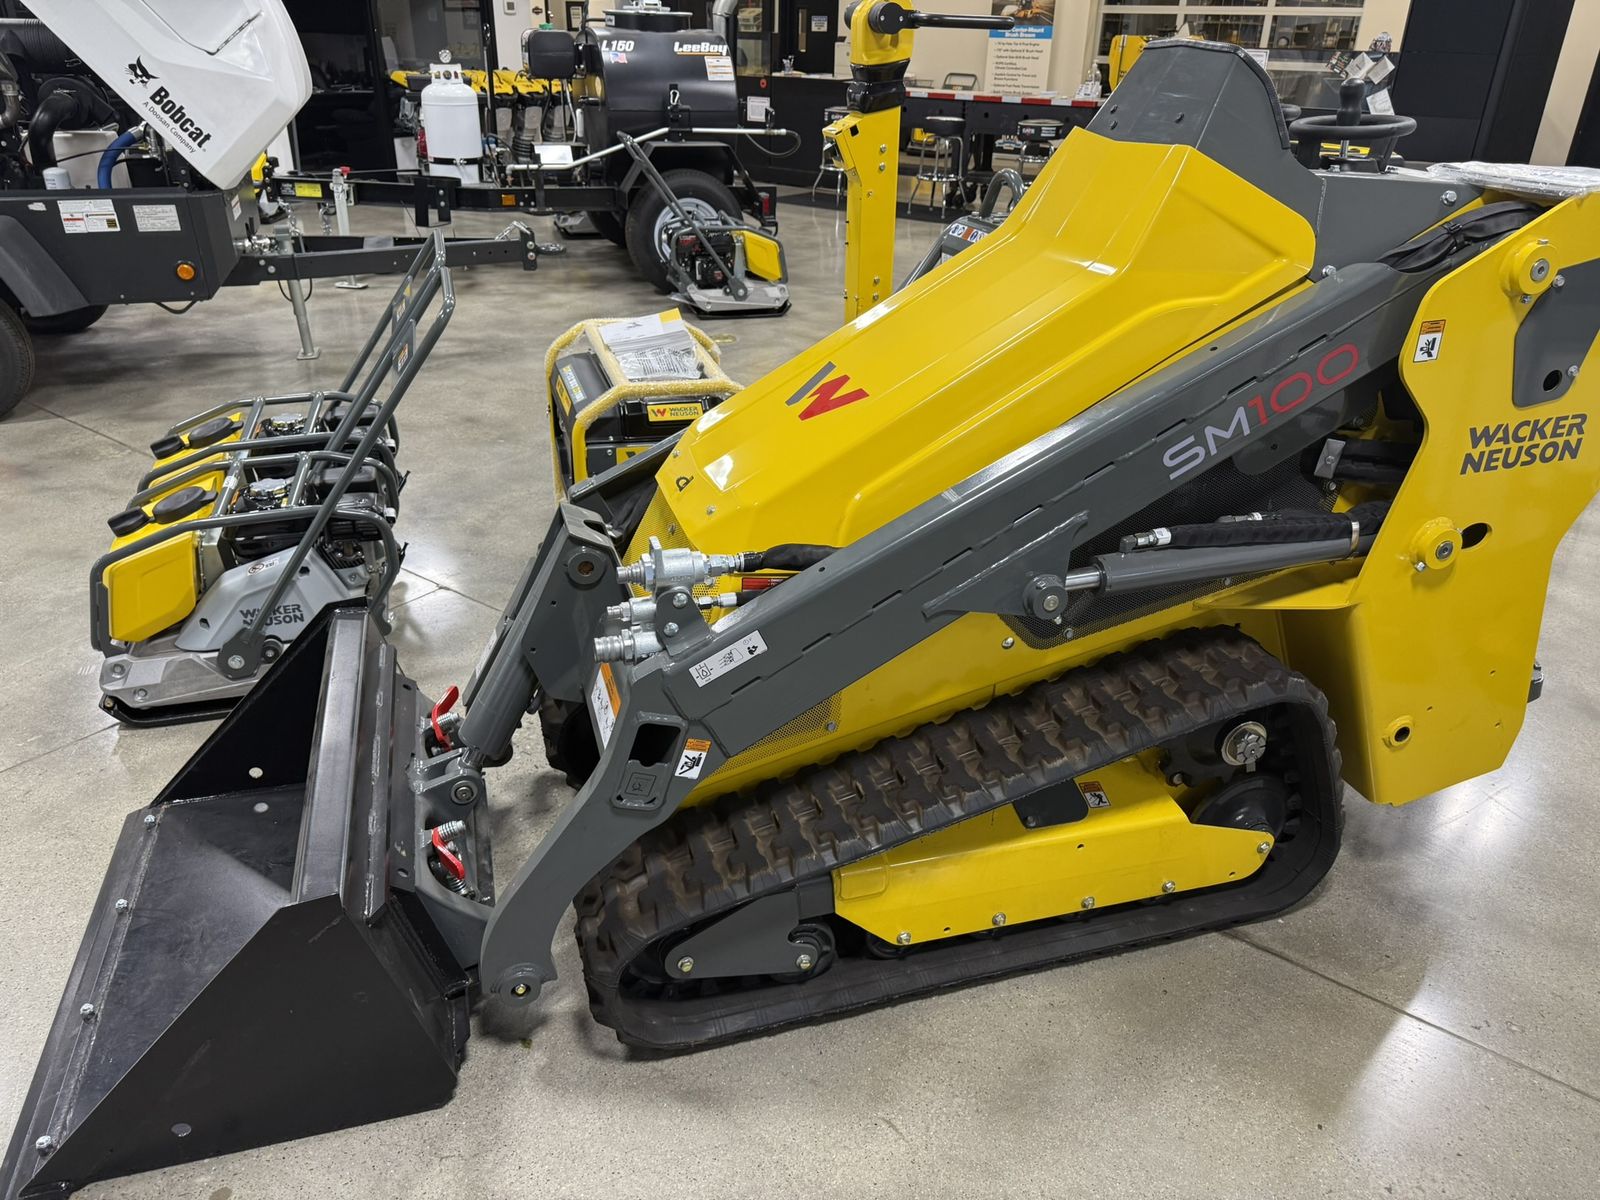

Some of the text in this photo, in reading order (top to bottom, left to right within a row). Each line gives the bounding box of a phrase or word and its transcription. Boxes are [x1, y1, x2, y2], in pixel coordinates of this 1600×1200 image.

[674, 41, 729, 56] LeeBoy
[148, 105, 170, 129] Doosan
[169, 126, 197, 154] Company
[149, 86, 212, 149] Bobcat
[1162, 342, 1360, 480] SM100
[1469, 413, 1588, 450] WACKER
[1460, 437, 1583, 475] NEUSON
